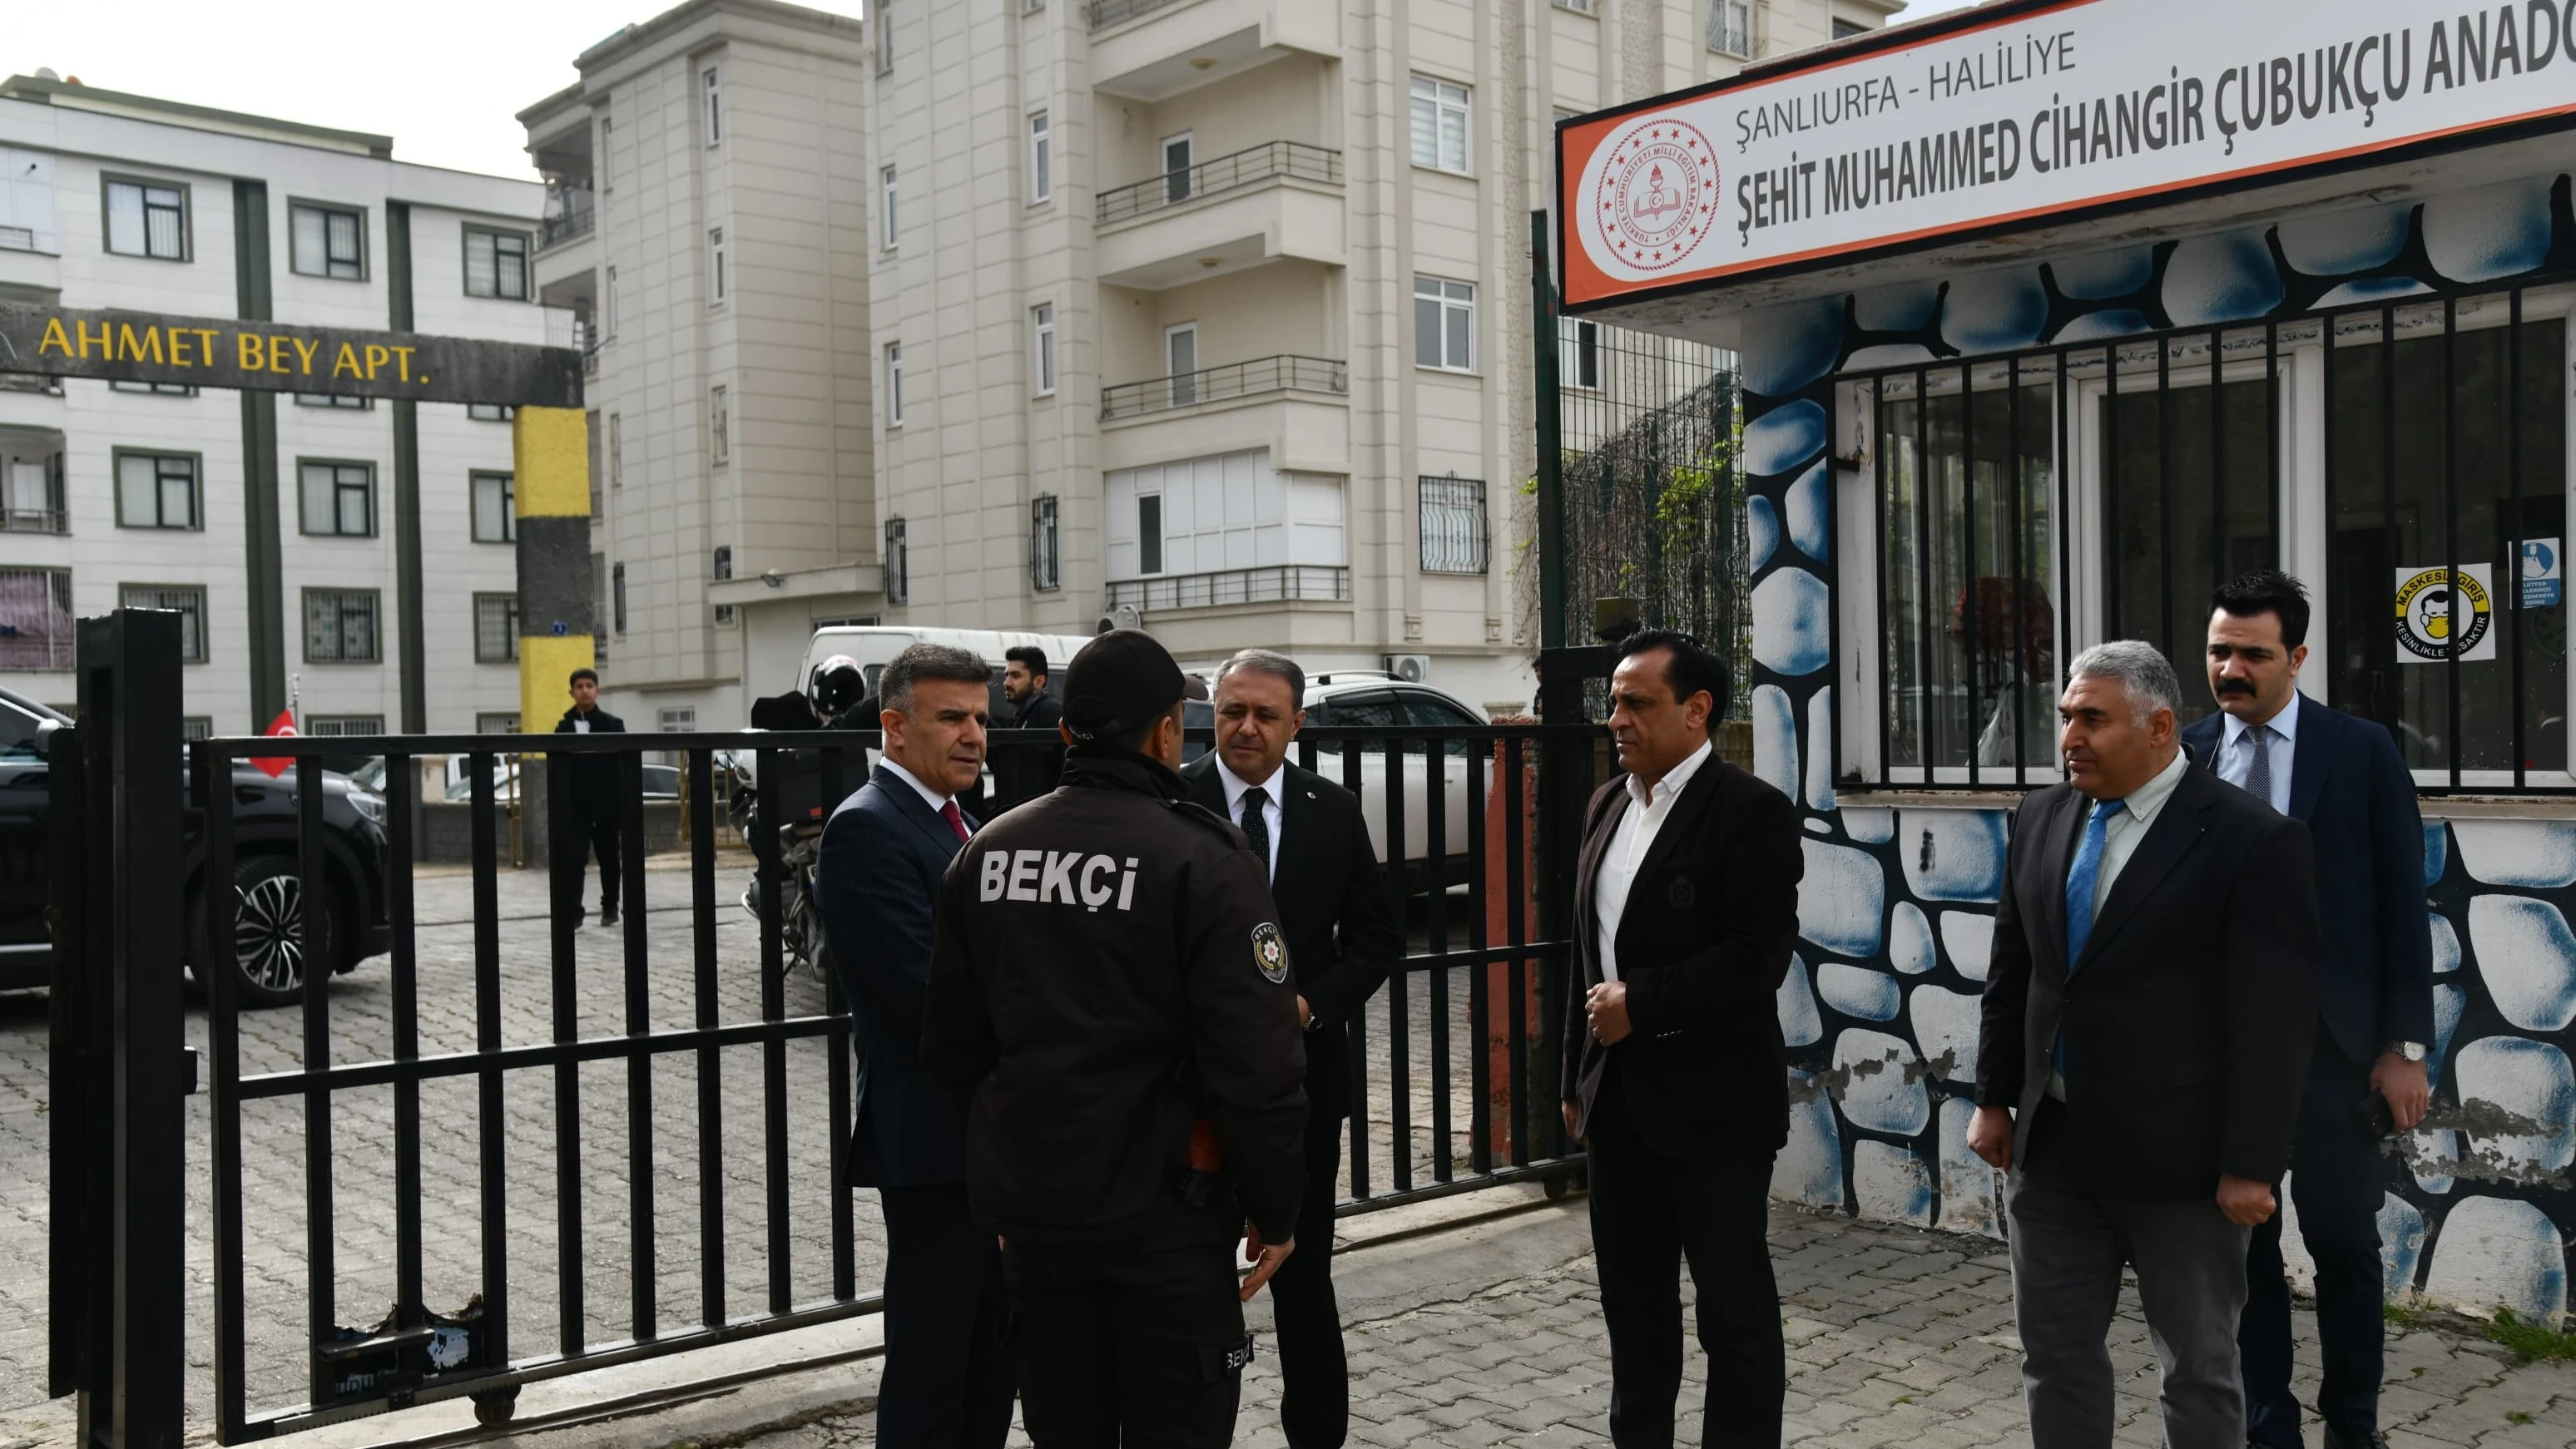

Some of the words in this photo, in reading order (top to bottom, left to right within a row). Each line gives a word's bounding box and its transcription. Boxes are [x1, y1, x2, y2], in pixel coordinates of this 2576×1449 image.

[1736, 76, 1900, 153] ŞANLIURFA
[1930, 31, 2075, 101] HALİLİYE
[1653, 146, 1677, 156] MİLLİ
[1737, 151, 1816, 247] ŞEHİT
[1825, 119, 2021, 215] MUHAMMED
[2030, 66, 2205, 173] CİHANGİR
[2215, 28, 2410, 156] ÇUBUKÇU
[1619, 150, 1652, 213] CUMHURİYETİ
[1677, 153, 1697, 185] EĞİTİM
[1621, 215, 1649, 243] TÜRKİYE
[1666, 187, 1697, 239] BAKANLIĞI
[39, 317, 220, 368] AHMET
[238, 333, 319, 375] BEY
[333, 343, 429, 385] APT.
[2397, 570, 2449, 606] MASKESİ
[2459, 576, 2484, 603] GİRİŞ
[2396, 621, 2445, 657] KESİNLİKLE
[2447, 616, 2486, 654] SAKTIR
